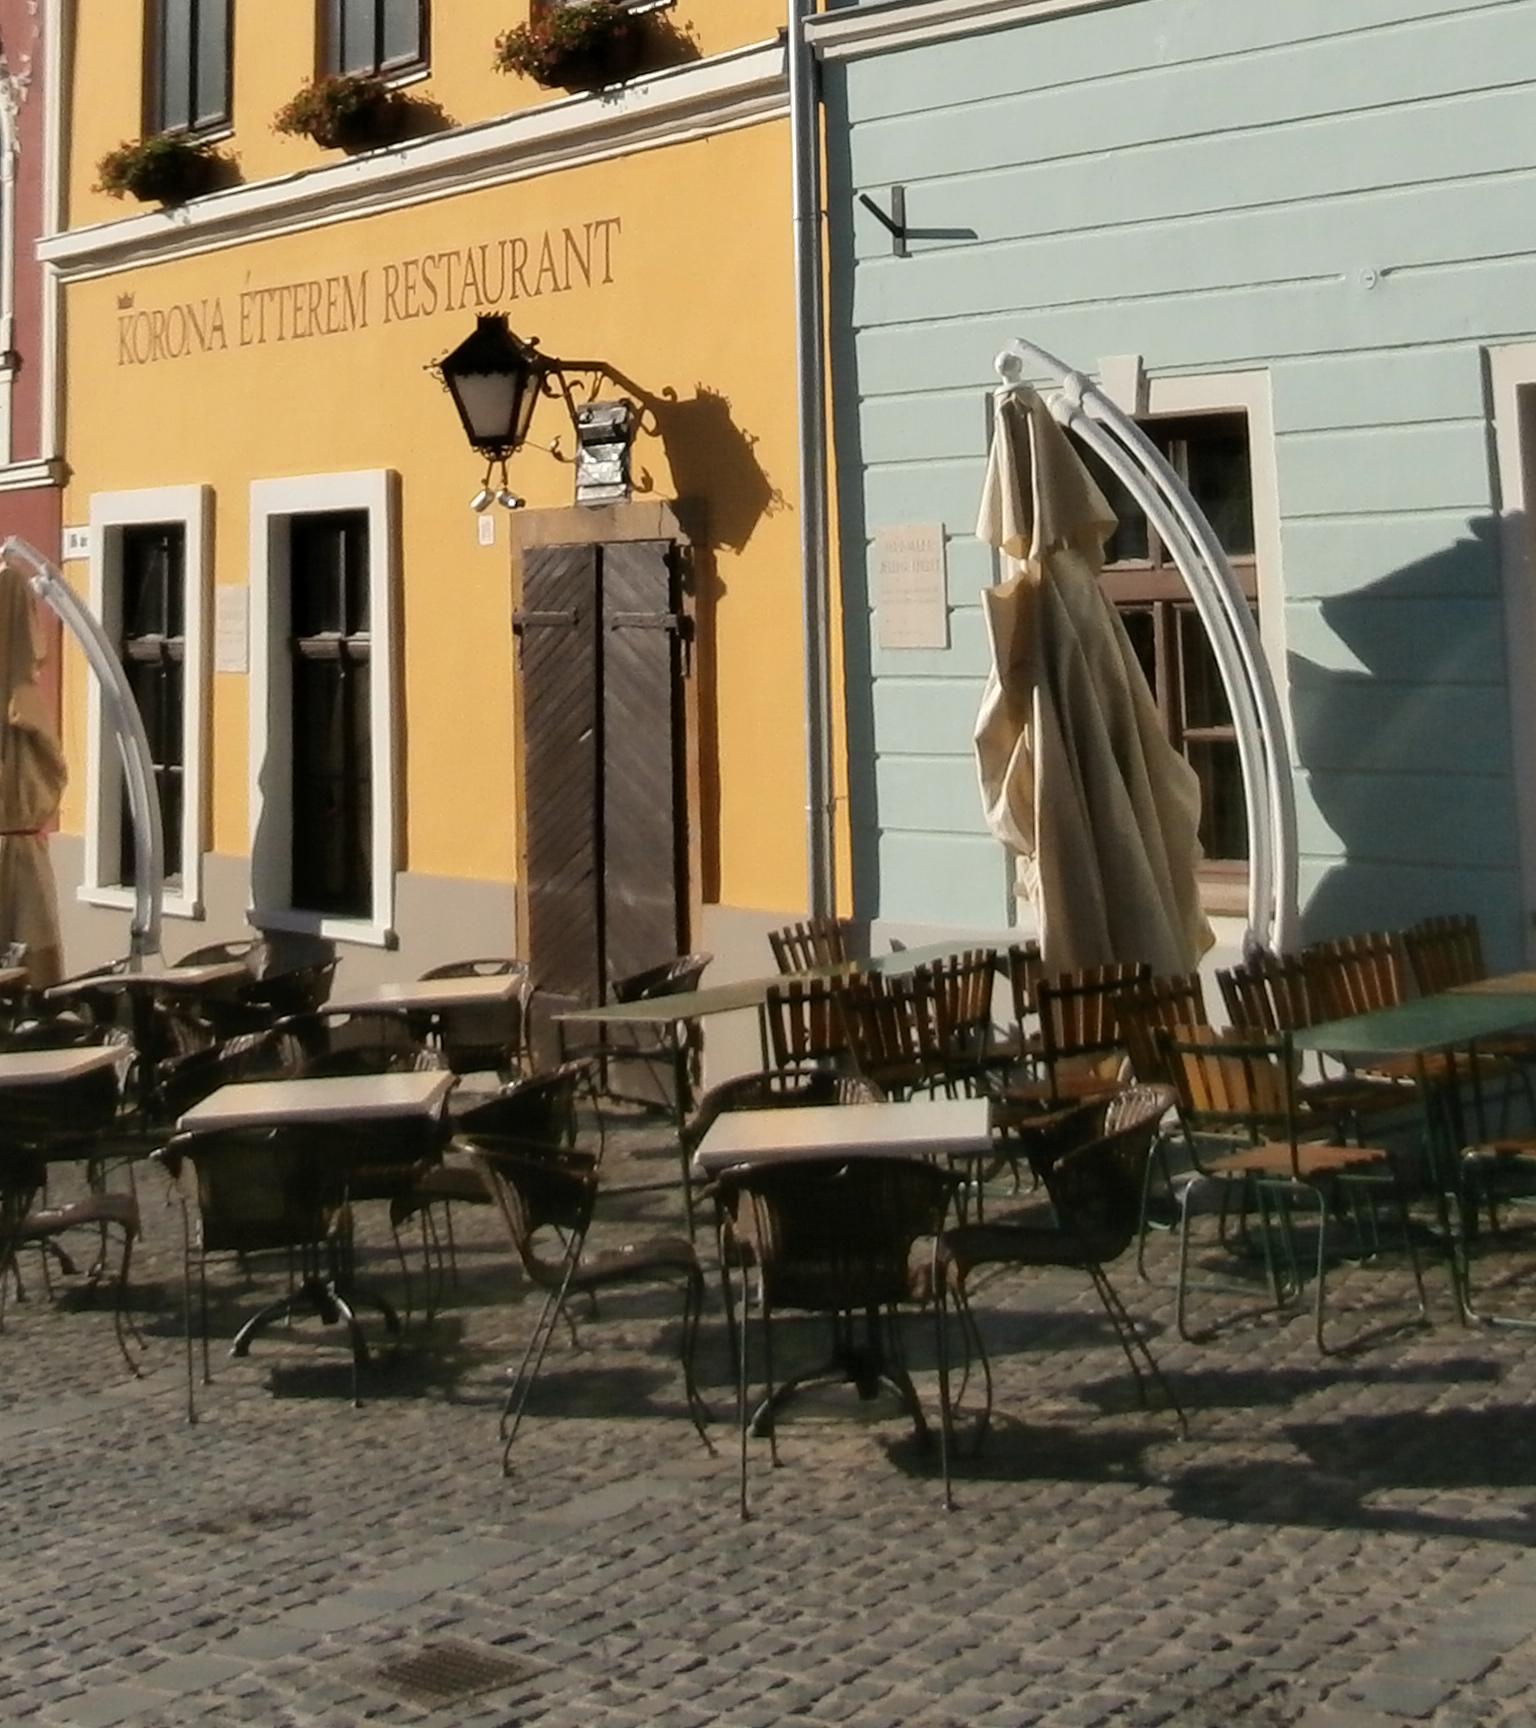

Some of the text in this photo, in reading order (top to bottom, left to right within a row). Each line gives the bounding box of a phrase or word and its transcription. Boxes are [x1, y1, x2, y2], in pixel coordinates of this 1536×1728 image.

[116, 216, 622, 367] KORONA ÉTTEREM RESTAURANT
